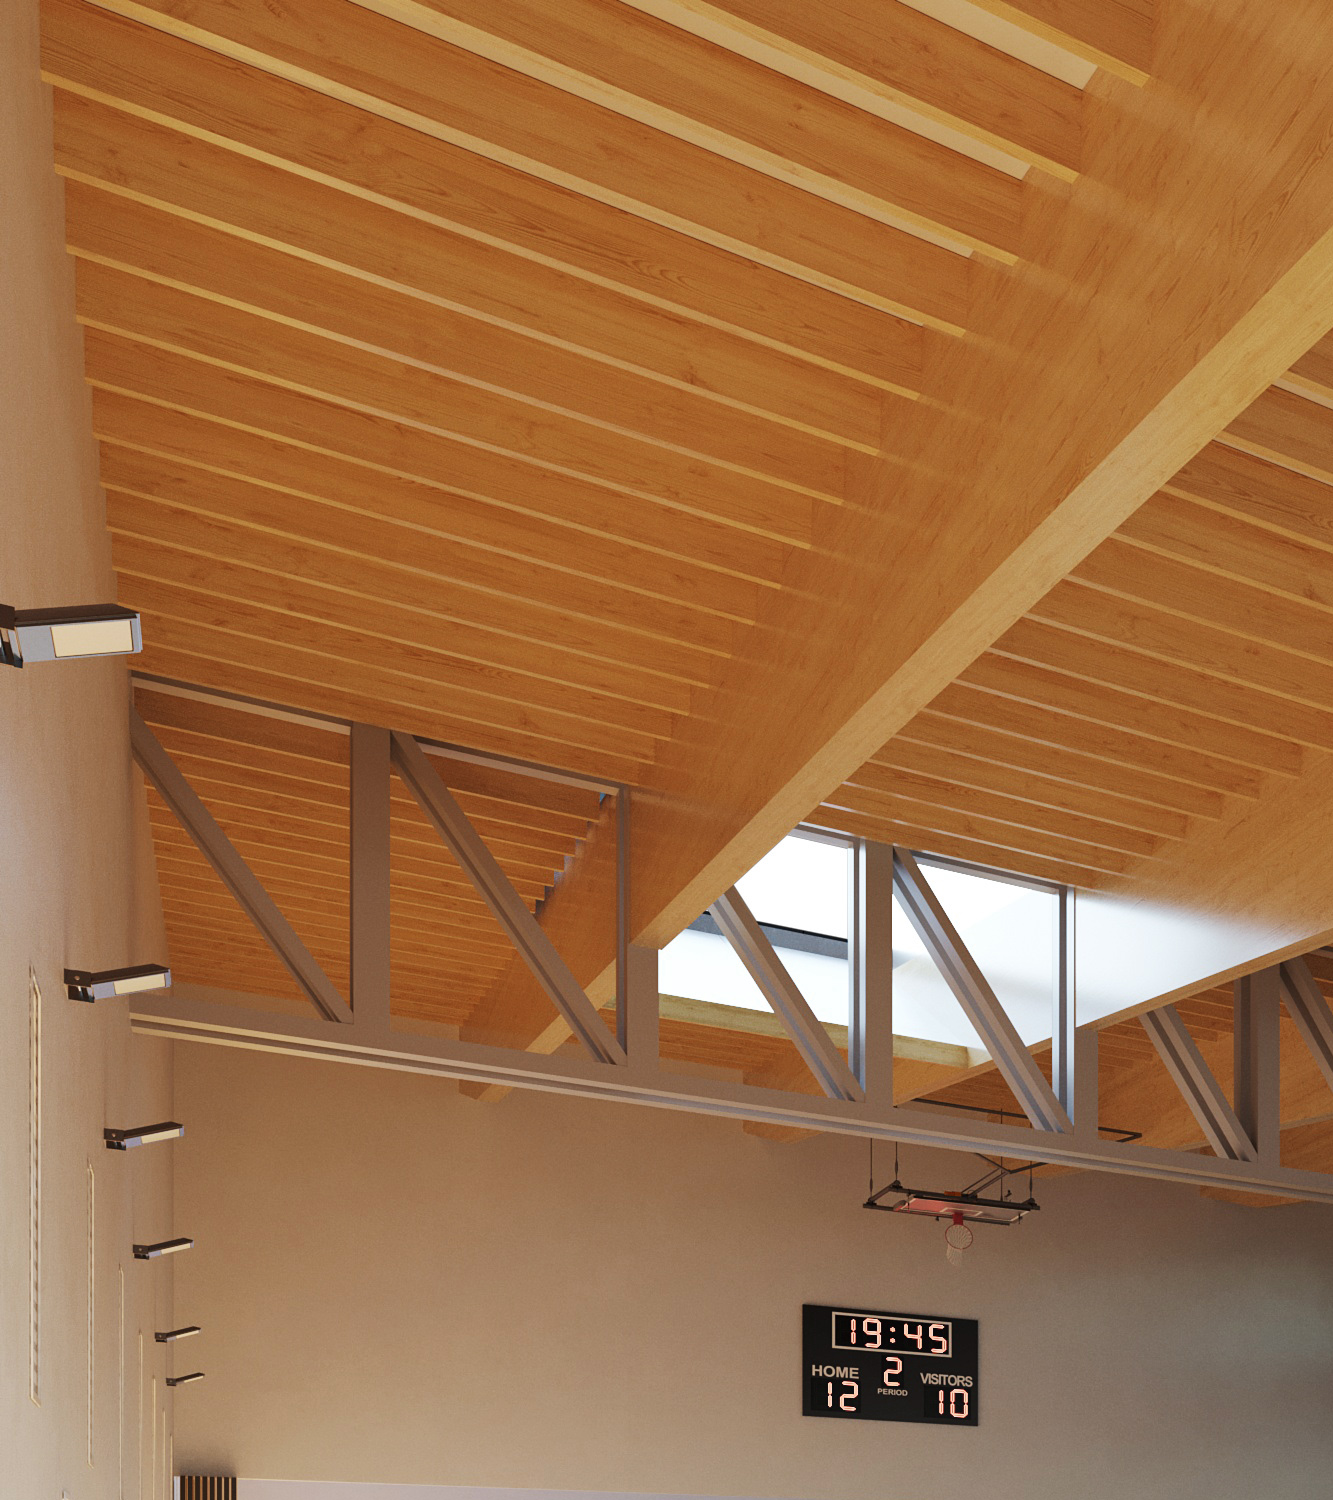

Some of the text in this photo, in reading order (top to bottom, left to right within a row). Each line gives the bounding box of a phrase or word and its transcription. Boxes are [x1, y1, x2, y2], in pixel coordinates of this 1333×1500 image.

[850, 1317, 948, 1354] 19:45
[811, 1364, 860, 1380] HOME
[883, 1356, 903, 1387] 2
[920, 1372, 973, 1387] VISITORS
[827, 1380, 859, 1412] 12
[877, 1387, 908, 1397] PERIOD
[938, 1388, 969, 1419] 10
